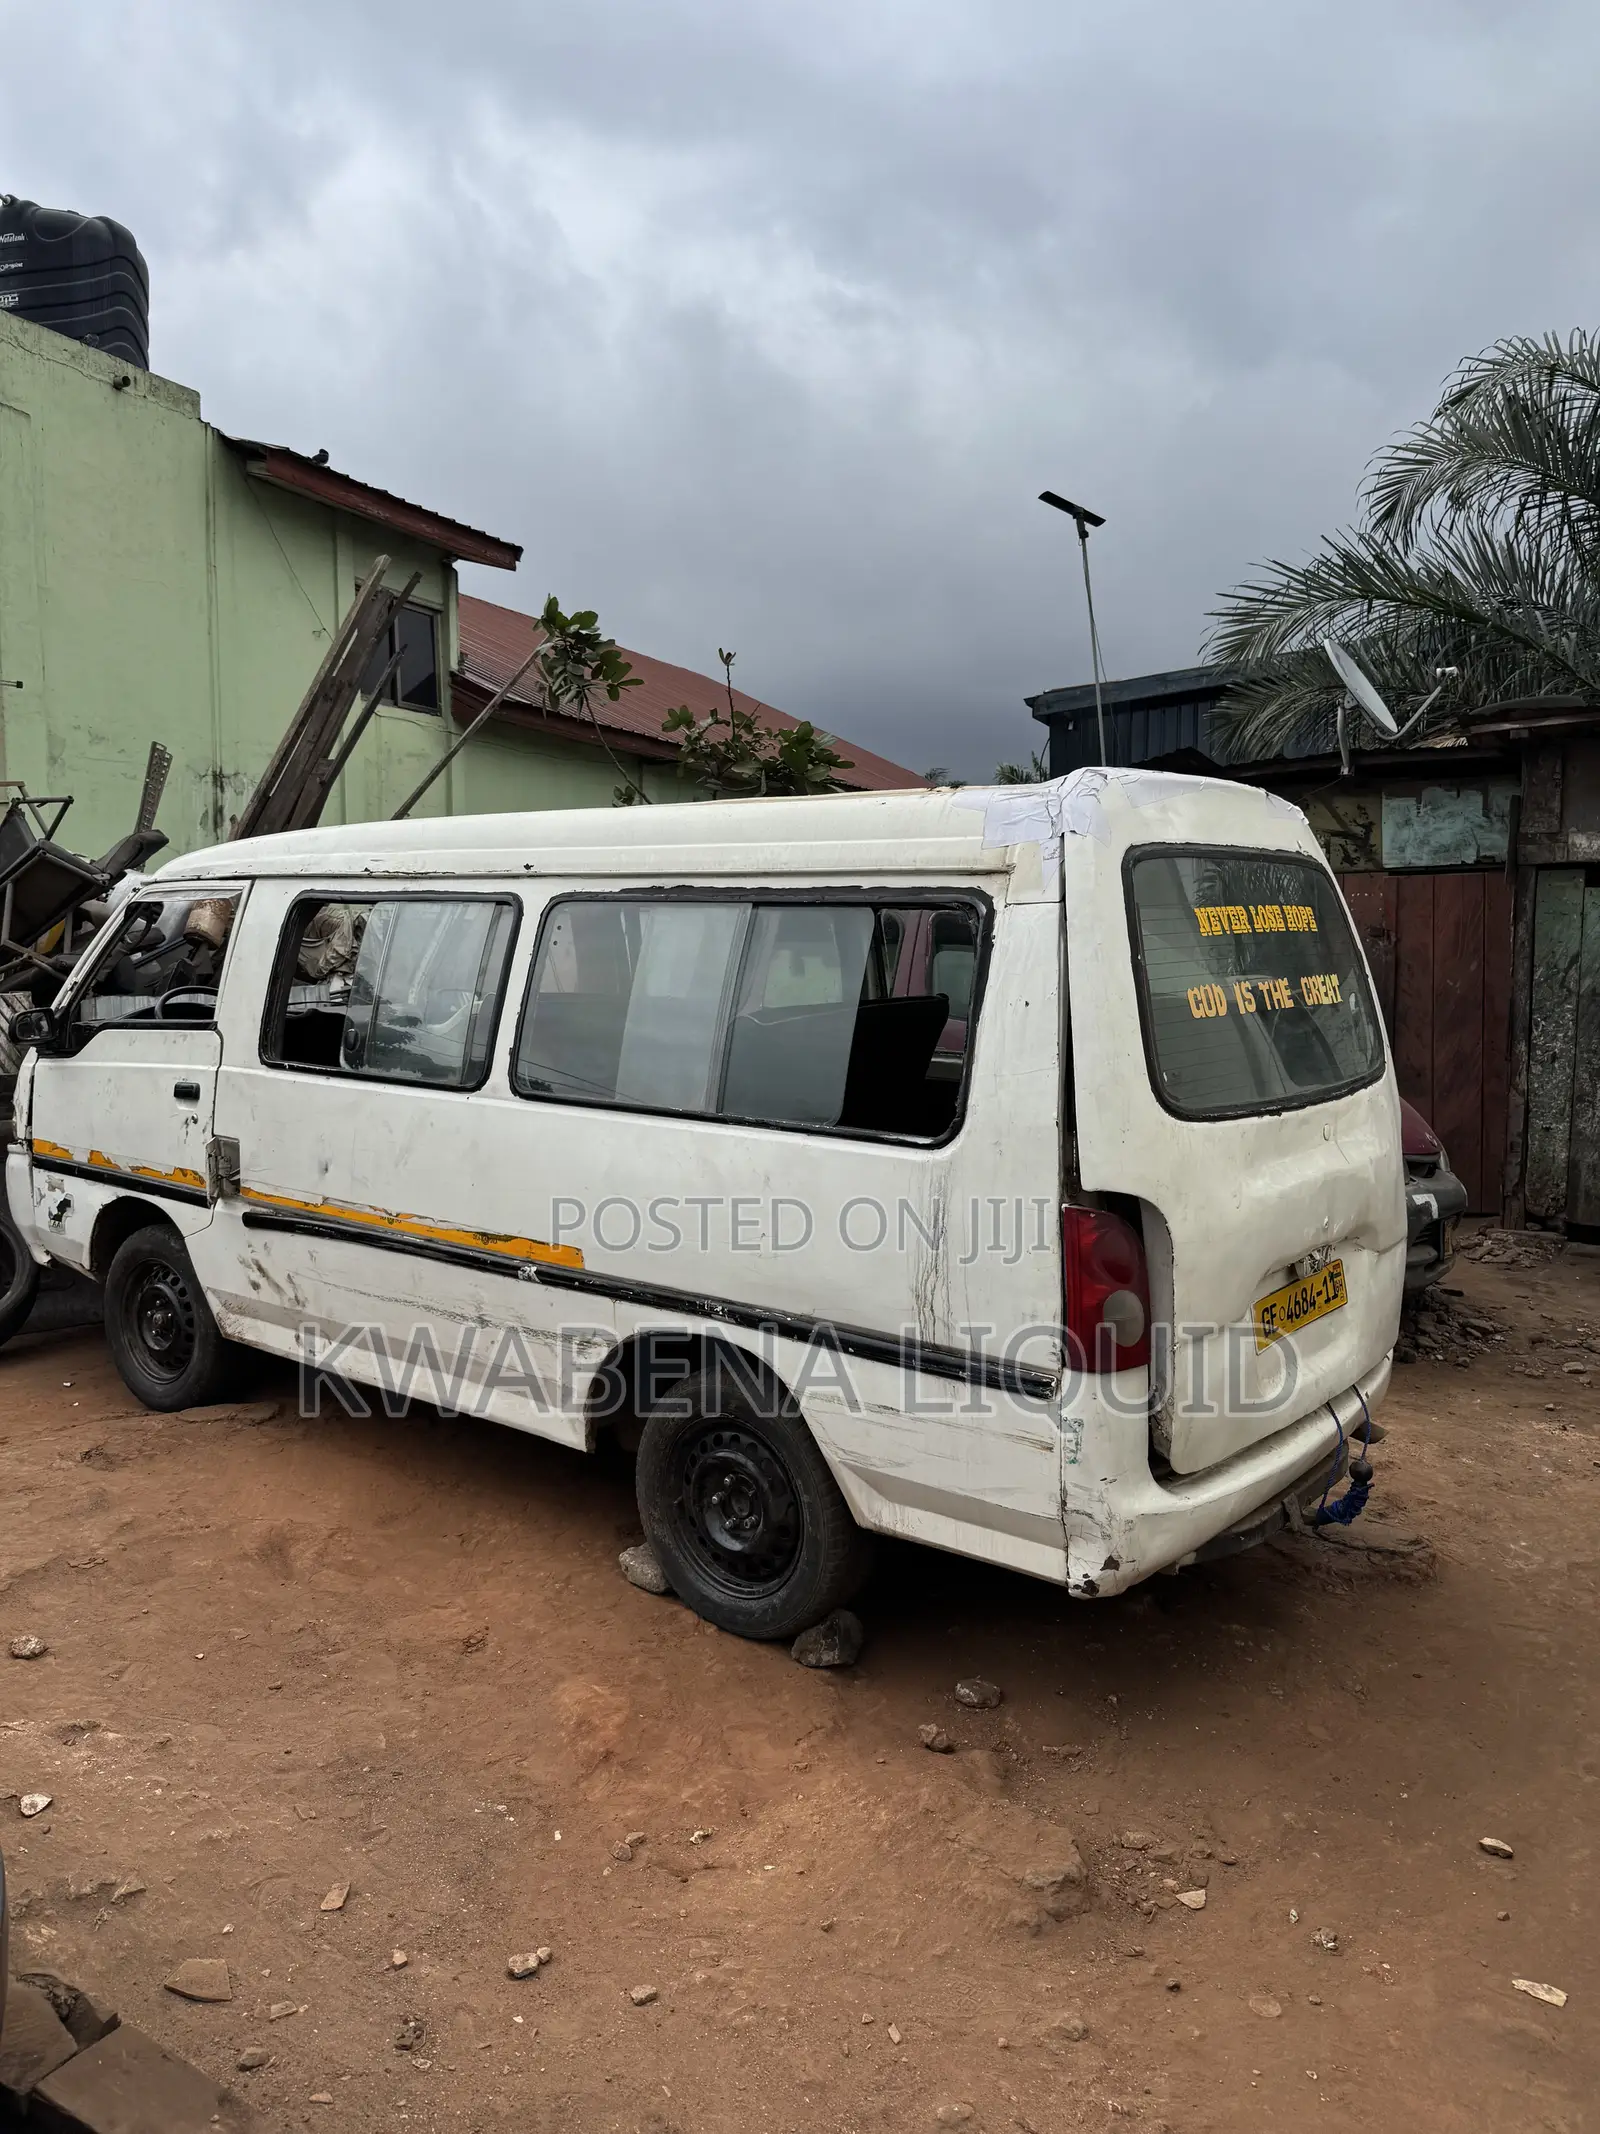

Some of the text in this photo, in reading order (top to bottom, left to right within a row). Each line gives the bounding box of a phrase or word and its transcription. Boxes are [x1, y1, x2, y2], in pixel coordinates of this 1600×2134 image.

[1194, 904, 1318, 936] NEVER LOSE HOPE
[1187, 983, 1228, 1019] GOD
[1233, 980, 1257, 1015] IS
[1258, 977, 1295, 1010] THE
